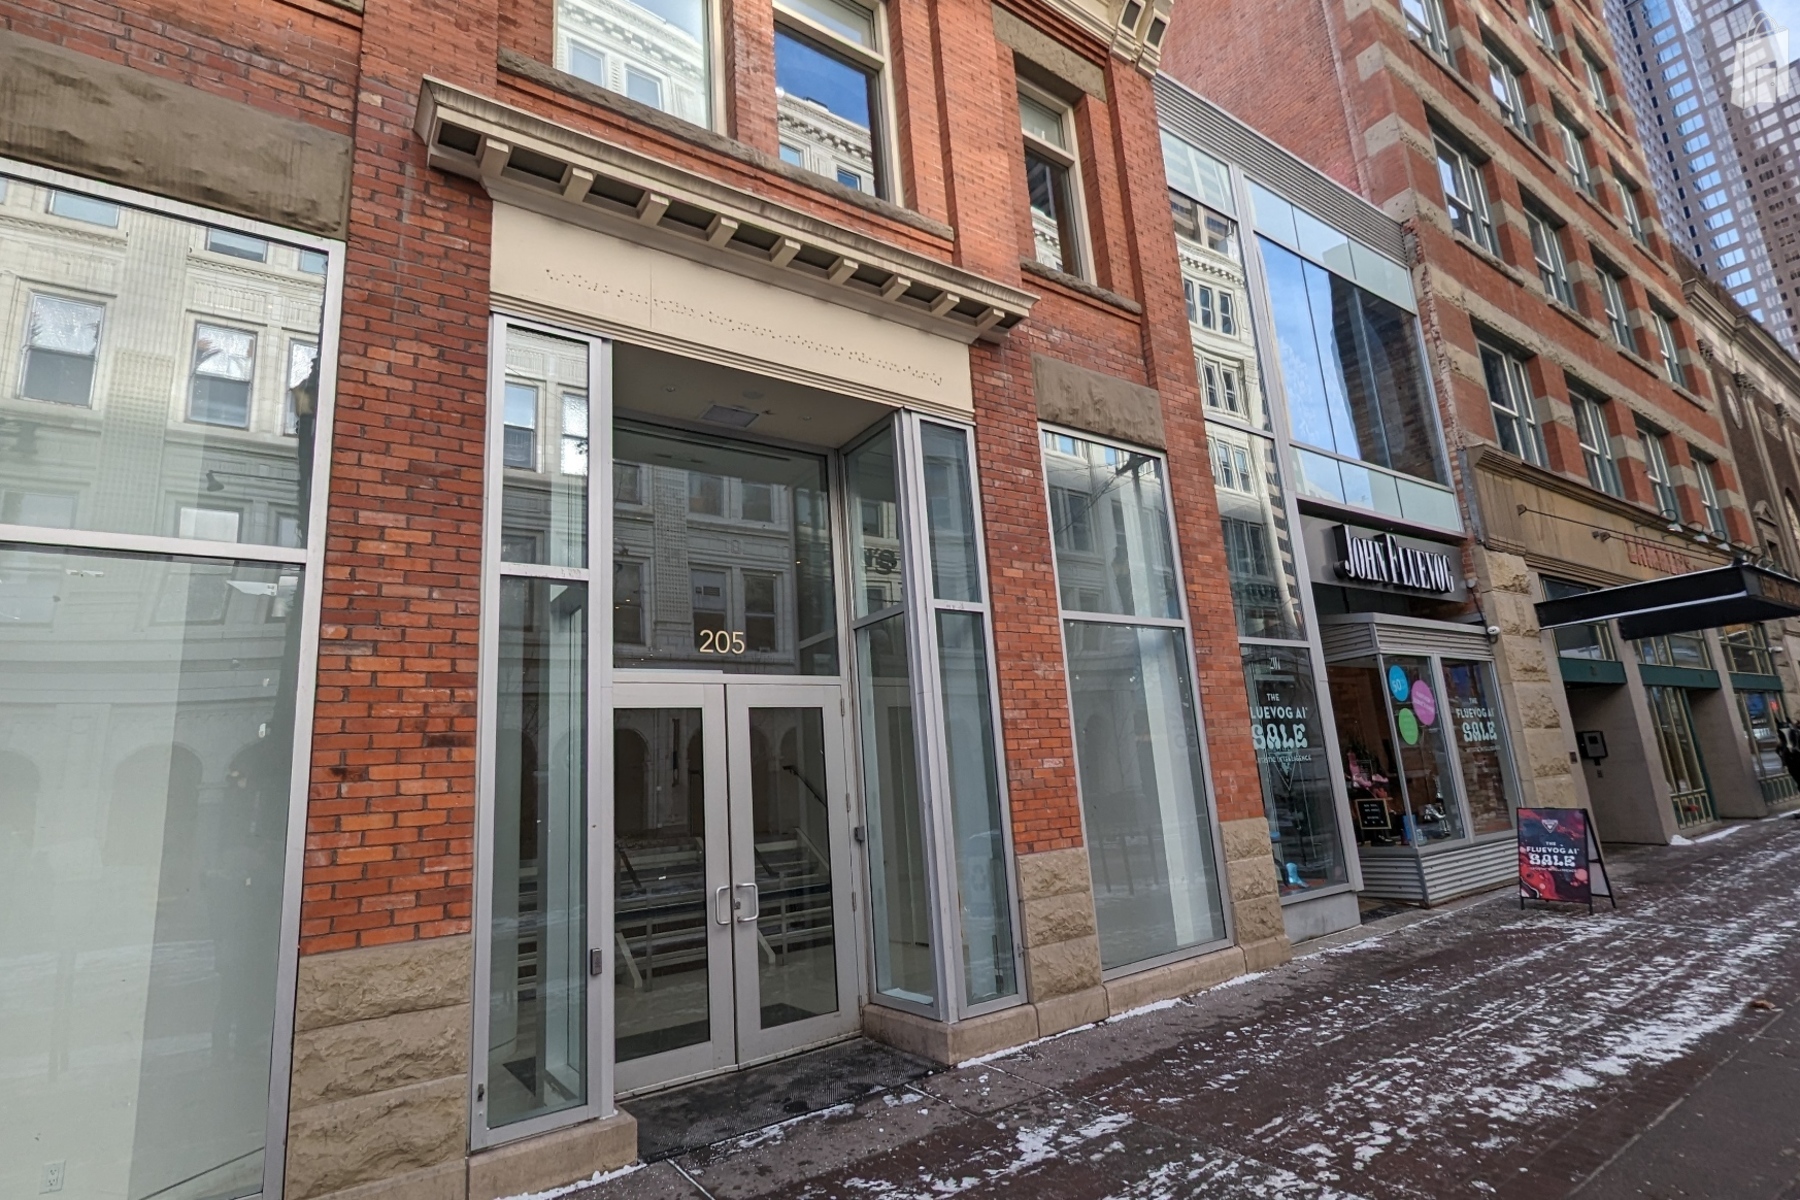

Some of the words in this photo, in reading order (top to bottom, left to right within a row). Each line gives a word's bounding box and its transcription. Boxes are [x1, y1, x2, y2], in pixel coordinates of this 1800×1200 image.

[1343, 523, 1388, 582] JOHN
[1385, 532, 1454, 593] FLUEVOG
[699, 629, 745, 654] 205
[1266, 693, 1280, 701] THE
[1249, 706, 1294, 719] LUEVOG
[1455, 707, 1488, 718] FLUEVOG
[1251, 723, 1308, 750] SALE
[1462, 721, 1498, 743] SALE
[1526, 846, 1566, 854] FLUEVOG
[1529, 853, 1576, 867] SALE
